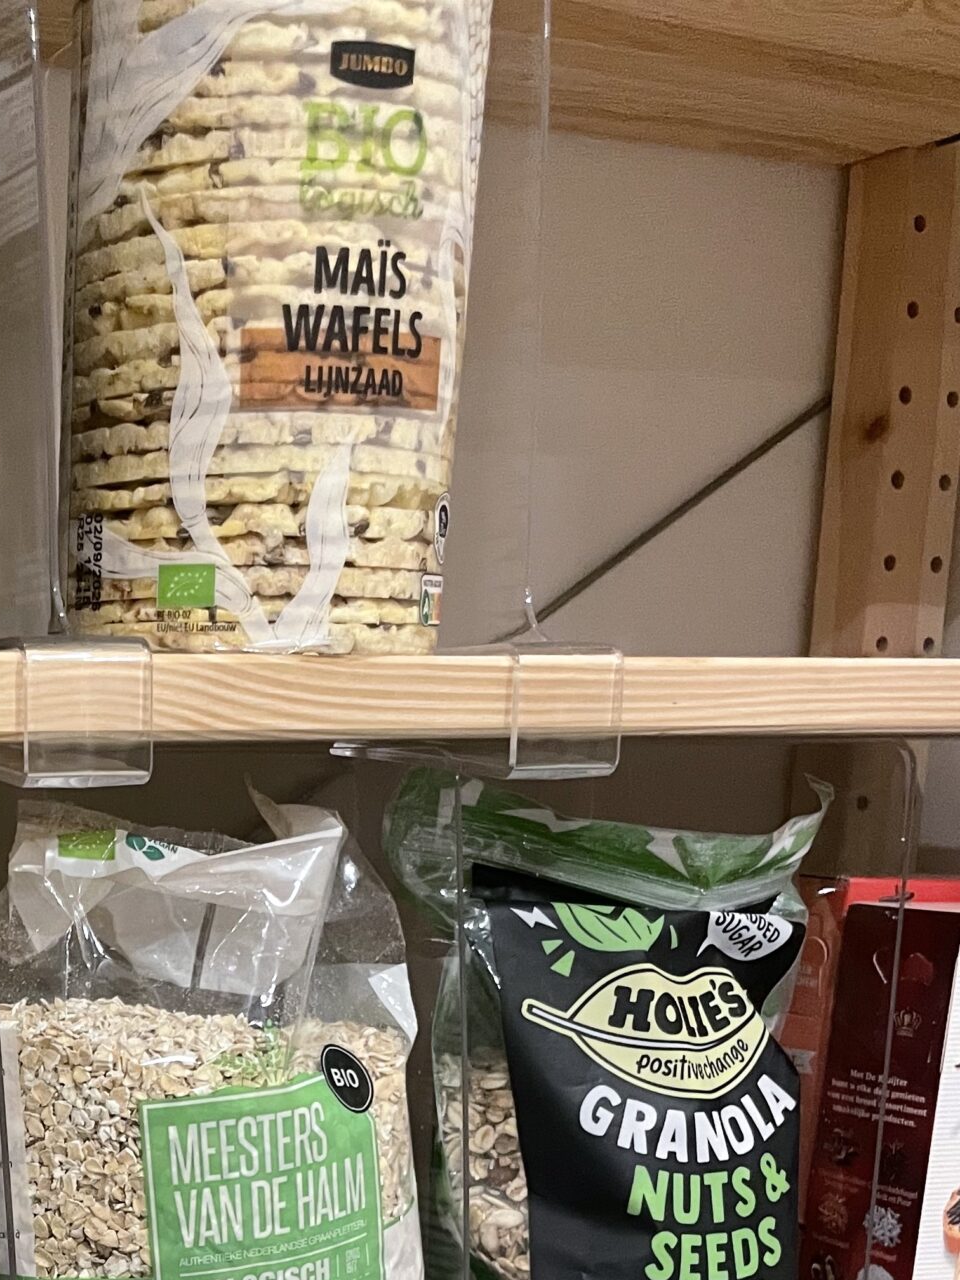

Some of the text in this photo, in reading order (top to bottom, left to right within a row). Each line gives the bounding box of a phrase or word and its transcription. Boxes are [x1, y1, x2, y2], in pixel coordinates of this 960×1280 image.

[338, 53, 408, 77] JUMBO
[300, 101, 428, 176] BIO
[313, 238, 407, 299] MAÏS
[281, 303, 424, 358] WAFELS
[303, 365, 404, 397] LIJNZAAD
[330, 1067, 360, 1089] BIO
[167, 1101, 328, 1186] MEESTERS
[579, 1073, 797, 1163] GRANOLA
[174, 1152, 366, 1249] VAN DE HALM
[626, 1164, 756, 1225] NUTS
[760, 1152, 790, 1203] &
